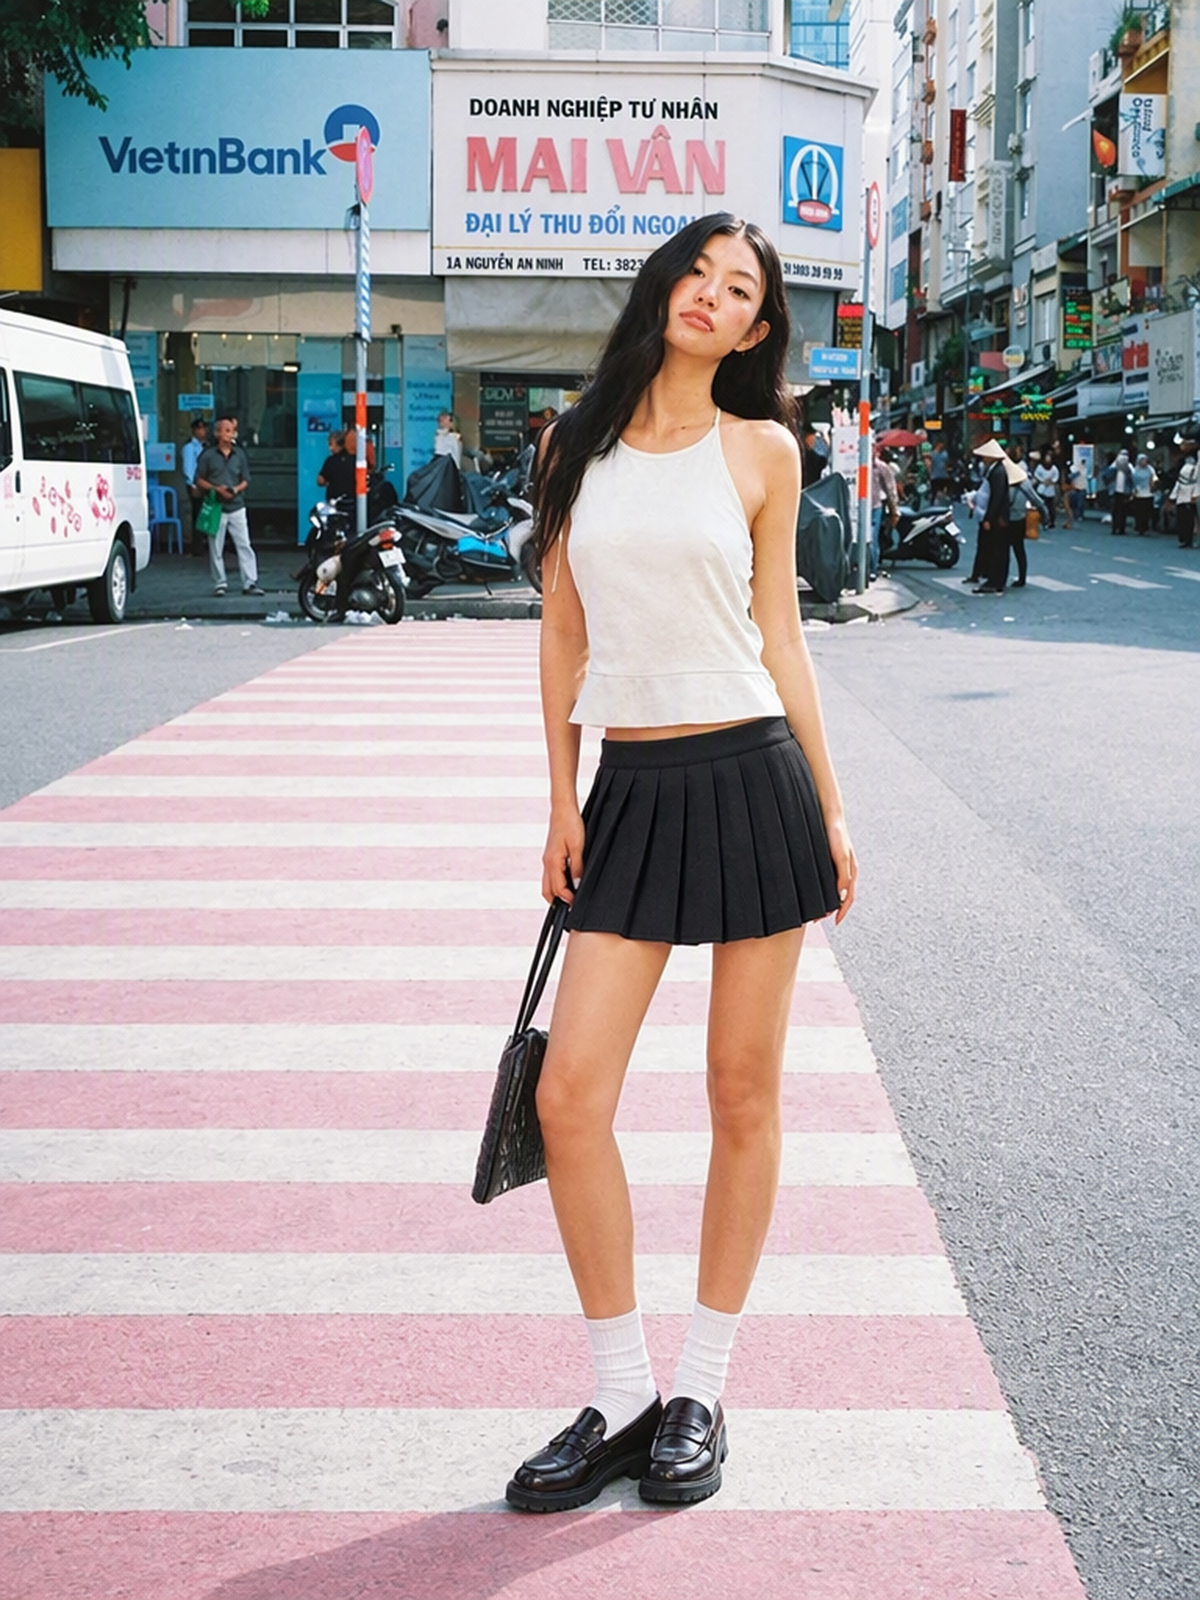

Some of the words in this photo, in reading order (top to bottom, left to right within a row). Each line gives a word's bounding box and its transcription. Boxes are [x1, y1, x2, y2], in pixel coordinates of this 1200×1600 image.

[469, 98, 540, 117] DOANH
[547, 96, 623, 122] NGHIỆP
[629, 98, 657, 119] TƯ
[661, 96, 718, 120] NHÂN
[98, 136, 328, 176] VietinBank
[466, 136, 589, 193] MAI
[605, 124, 727, 195] VÂN
[465, 212, 502, 238] ĐẠI
[509, 207, 532, 234] LÝ
[540, 213, 582, 234] THU
[588, 204, 625, 235] ĐỔI
[446, 256, 462, 270] 1A
[516, 257, 534, 270] AN
[535, 257, 564, 270] NINH
[582, 257, 611, 271] TEL:
